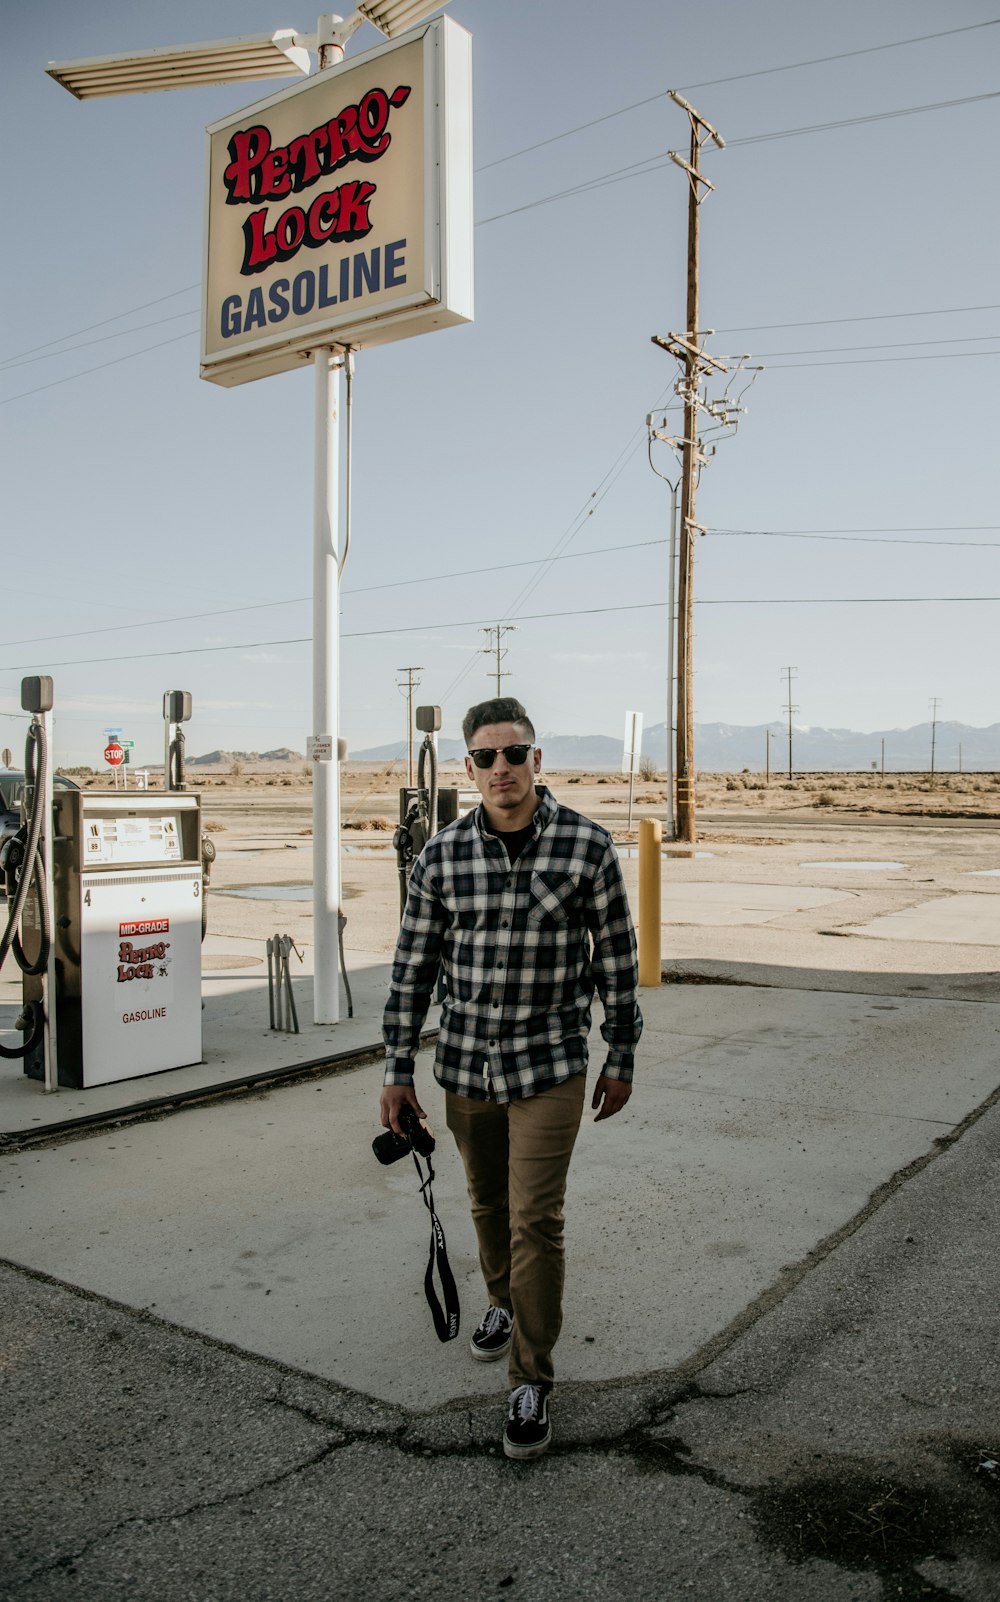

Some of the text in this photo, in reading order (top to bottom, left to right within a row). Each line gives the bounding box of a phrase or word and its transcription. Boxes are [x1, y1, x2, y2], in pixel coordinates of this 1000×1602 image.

[240, 180, 377, 275] LOCK
[220, 238, 407, 339] GASOLINE
[105, 750, 123, 759] STOP
[84, 889, 91, 906] 4
[193, 881, 199, 897] 3
[121, 921, 168, 935] MID-GRADE
[117, 964, 154, 982] LOCK
[122, 1007, 167, 1024] GASOLINE
[449, 1313, 457, 1337] SONY
